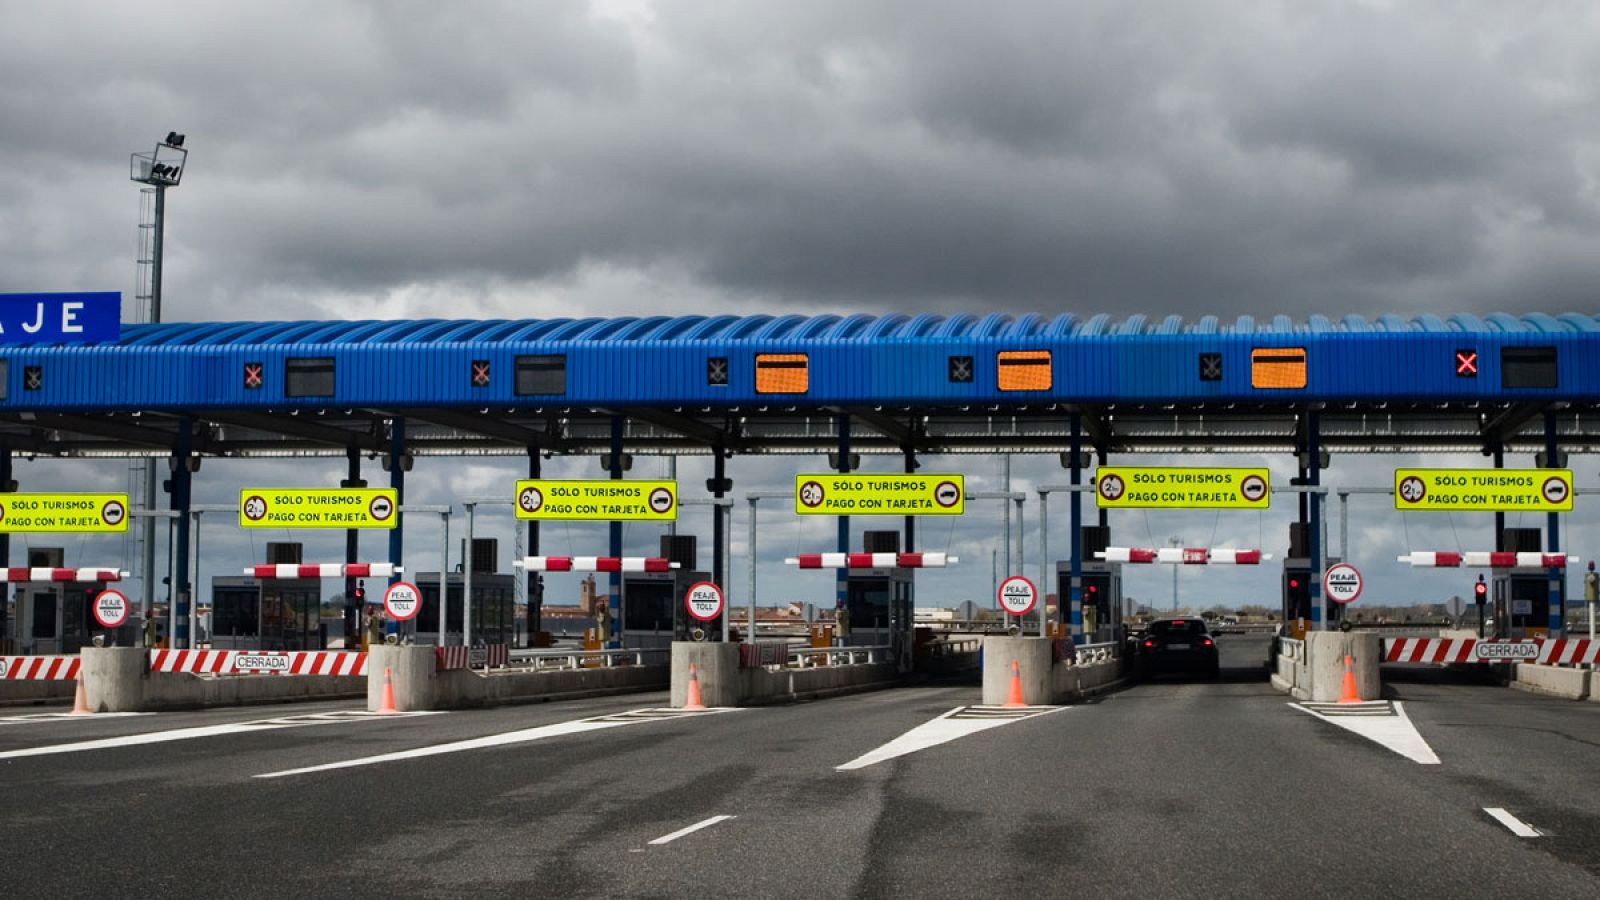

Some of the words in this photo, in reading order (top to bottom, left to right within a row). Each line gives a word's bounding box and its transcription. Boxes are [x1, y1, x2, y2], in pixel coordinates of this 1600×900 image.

[1170, 474, 1232, 483] TURISMOS
[1472, 477, 1533, 486] TURISMOS
[832, 480, 863, 490] SÓLO
[868, 482, 926, 490] TURISMOS
[584, 488, 640, 497] TURISMOS
[1128, 492, 1158, 501] PAGO
[1162, 492, 1185, 501] CON
[1189, 492, 1237, 502] TARJETA
[308, 496, 362, 505] TURISMOS
[826, 500, 855, 508] PAGO
[859, 500, 882, 508] CON
[887, 500, 933, 508] TARJETA
[1428, 495, 1458, 504] PAGO
[1462, 495, 1487, 504] CON
[1490, 495, 1540, 504] TARJETA
[43, 500, 94, 510] TURISMOS
[544, 505, 572, 514] PAGO
[576, 505, 597, 514] CON
[601, 505, 647, 514] TARJETA
[268, 512, 295, 521] PAGO
[298, 512, 320, 521] CON
[324, 512, 368, 521] TARJETA
[6, 518, 32, 526] PAGO
[34, 518, 56, 526] CON
[59, 518, 100, 526] TARJETA
[1480, 645, 1536, 656] CERRADA
[238, 656, 286, 668] CERRADA
